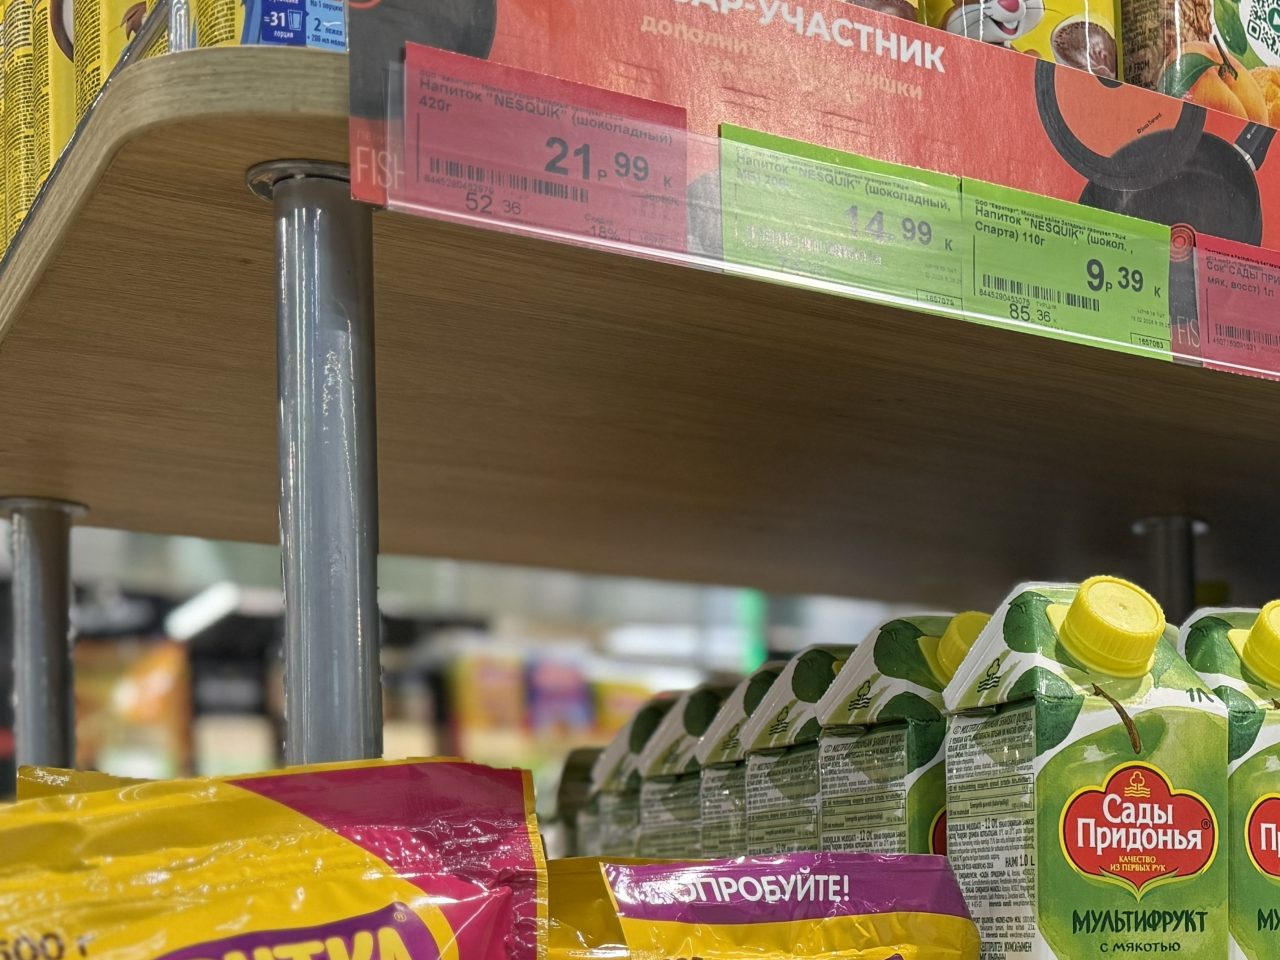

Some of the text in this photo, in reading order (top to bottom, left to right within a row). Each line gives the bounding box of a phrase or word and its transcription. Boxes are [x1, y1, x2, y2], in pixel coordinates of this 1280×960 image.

[545, 136, 649, 181] 21 99
[466, 192, 521, 215] 52 36
[902, 217, 932, 245] 99
[975, 205, 1085, 240] Напиток "NESQUIK"
[975, 220, 1018, 242] Спарта)
[1086, 258, 1144, 292] 9 39
[1009, 303, 1051, 323] 85 36
[1102, 793, 1174, 826] Сады
[1076, 817, 1202, 855] Придонья
[1118, 855, 1156, 863] КАЧЕСТВО
[676, 865, 850, 902] ОПРОБУЙТЕ!
[1072, 909, 1208, 935] МУЛЬТИФРУКТ
